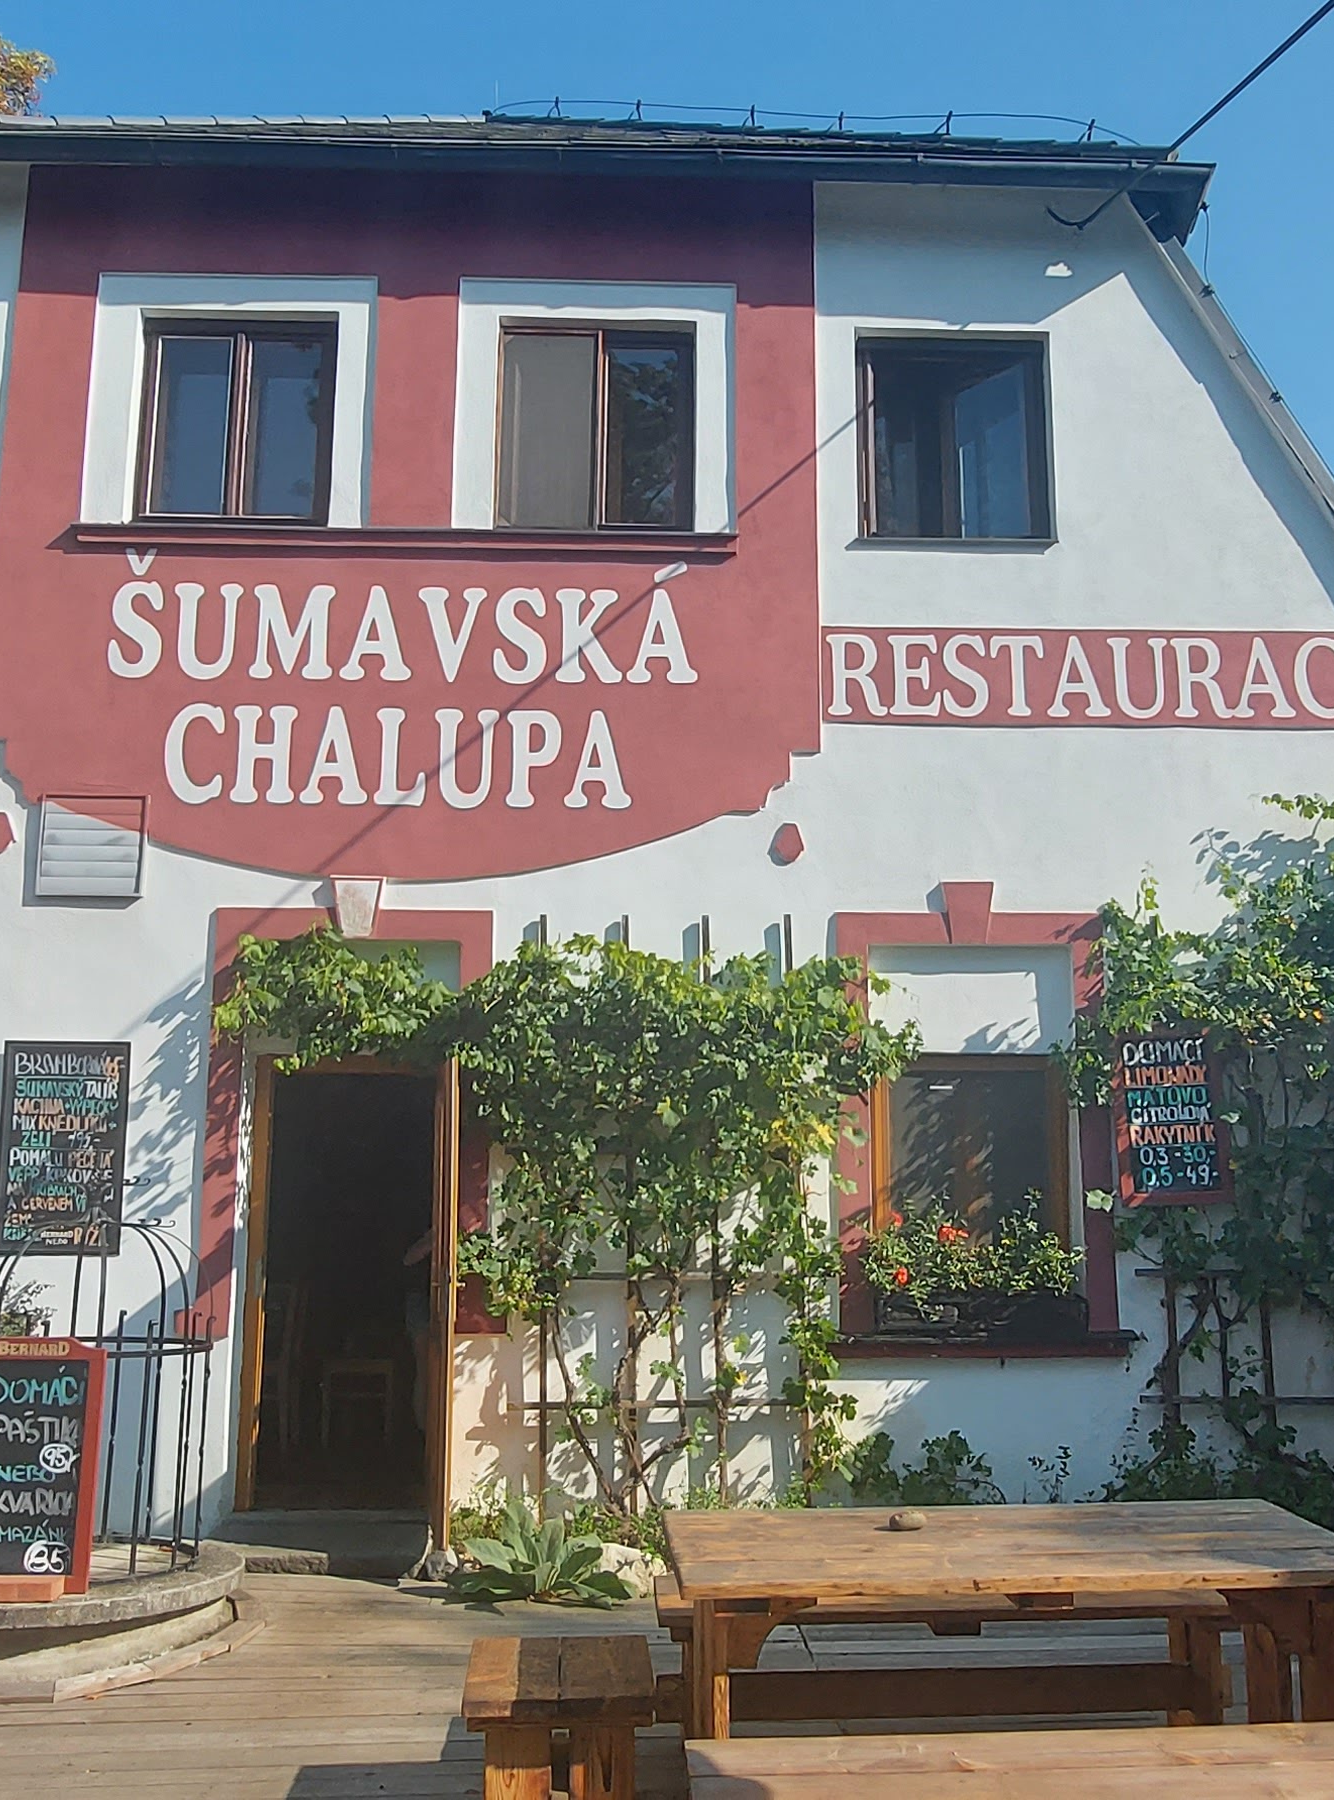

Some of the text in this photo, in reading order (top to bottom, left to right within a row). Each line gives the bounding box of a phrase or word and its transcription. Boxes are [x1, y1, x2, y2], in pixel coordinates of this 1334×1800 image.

[107, 547, 698, 685] ŠUMAVSKÁ
[164, 703, 632, 809] CHALUPA
[12, 1114, 37, 1130] MIX
